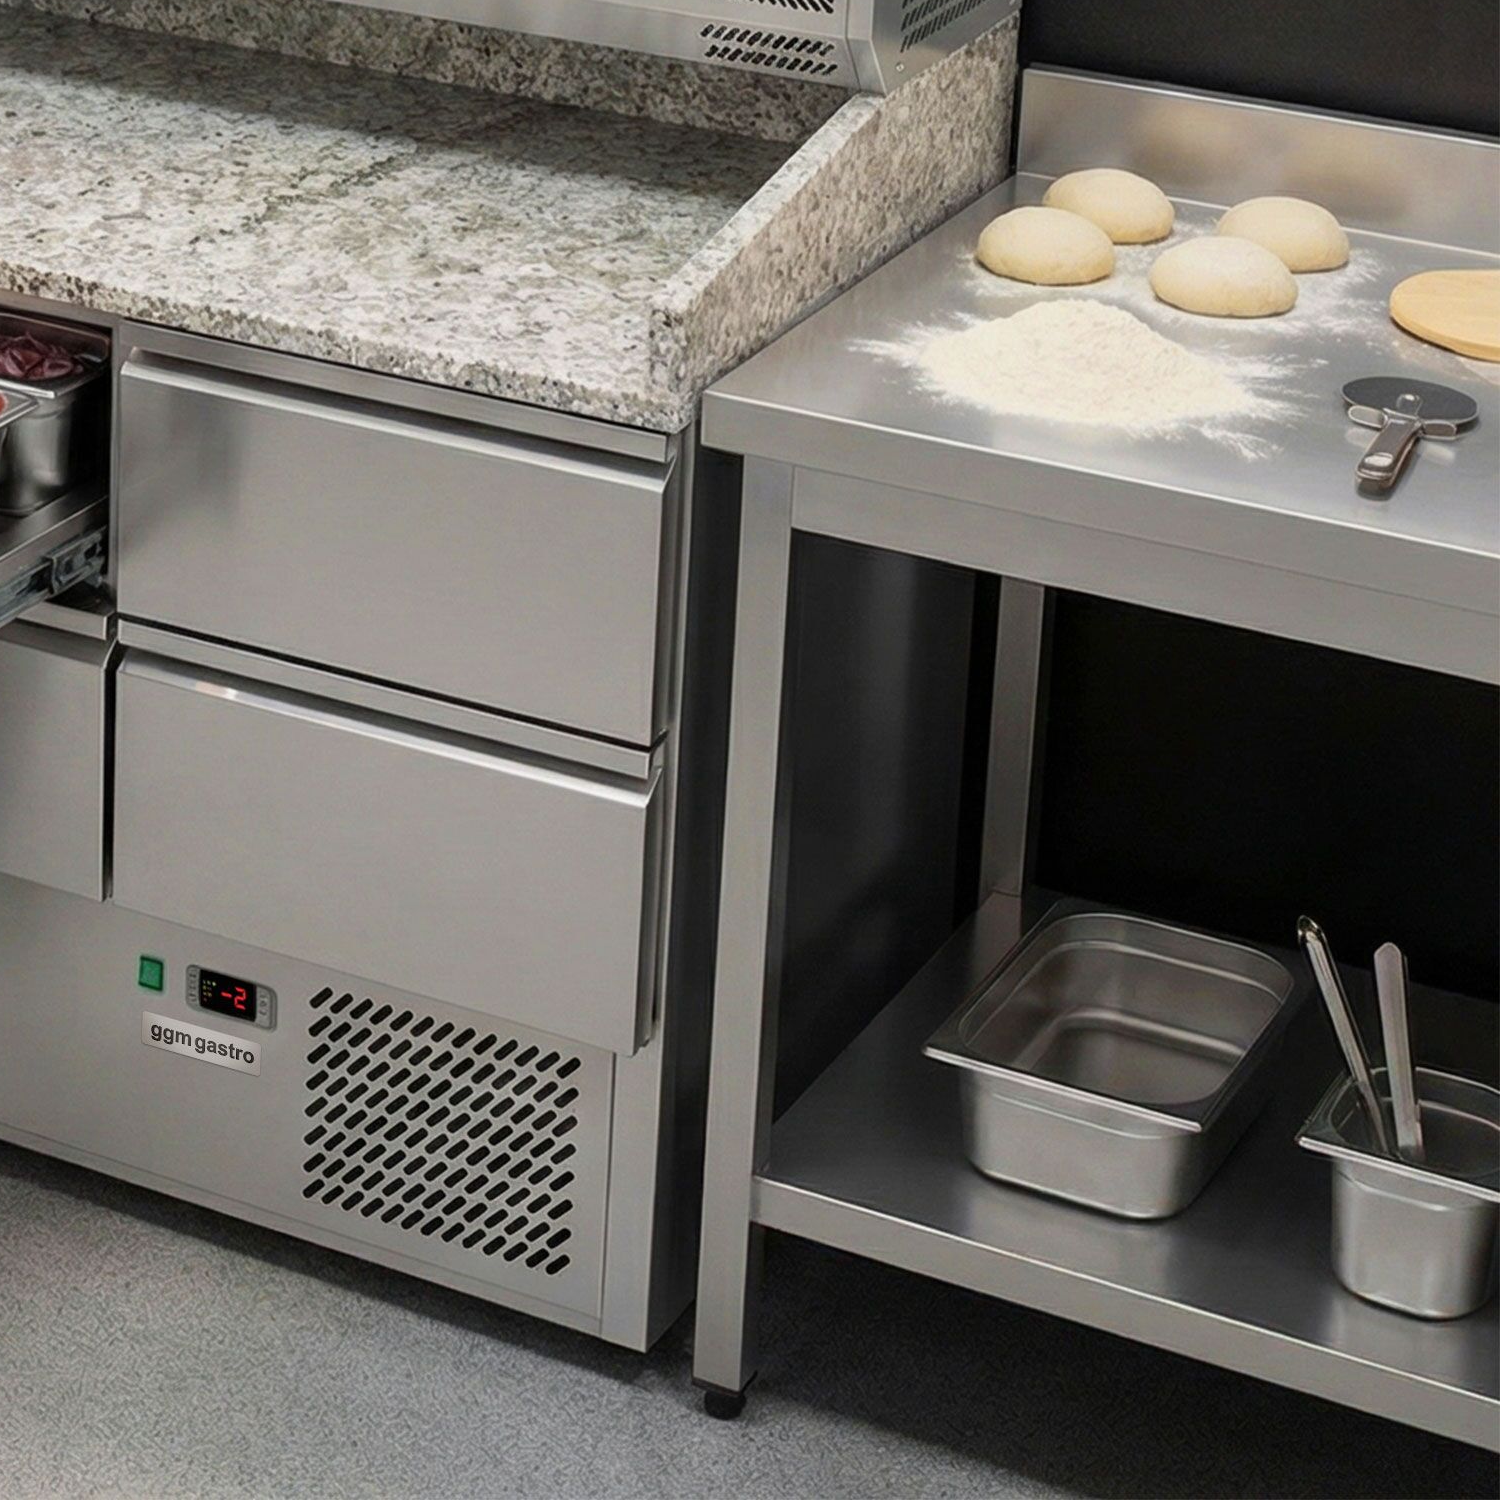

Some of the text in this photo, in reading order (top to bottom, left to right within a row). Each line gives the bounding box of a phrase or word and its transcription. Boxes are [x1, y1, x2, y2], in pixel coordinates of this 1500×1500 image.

[221, 986, 246, 1010] -2
[150, 1024, 255, 1064] ggm gastro
